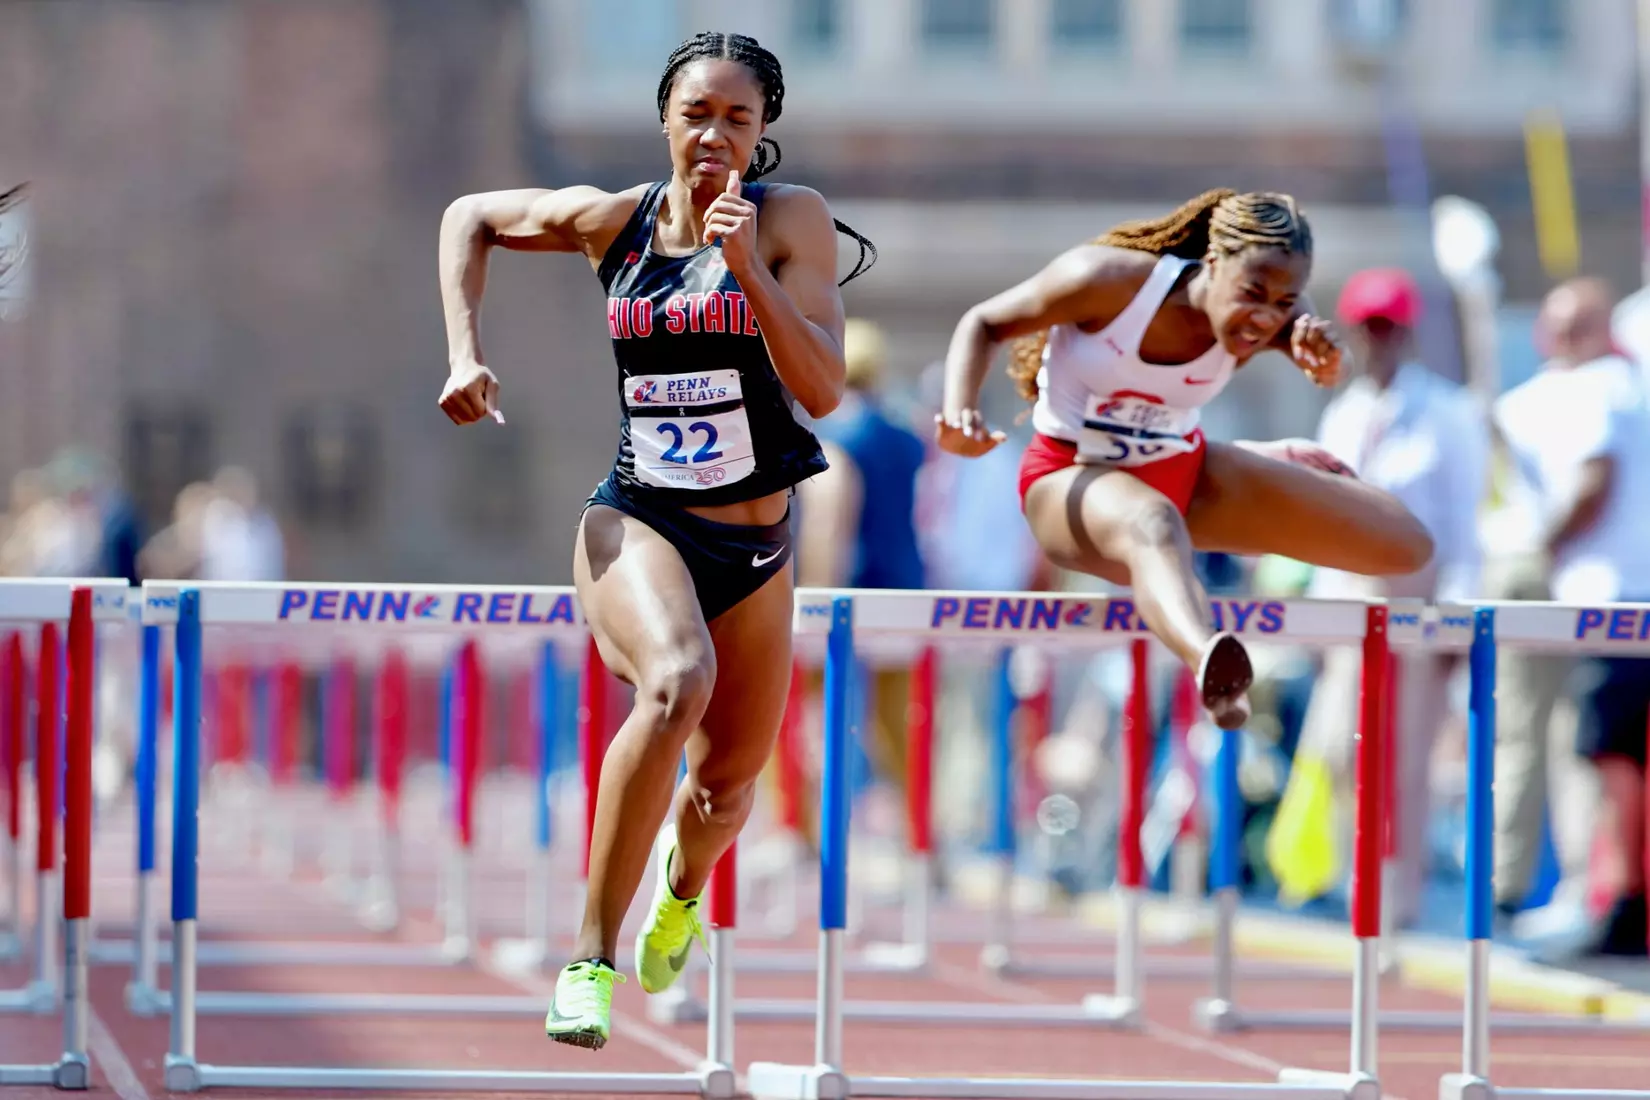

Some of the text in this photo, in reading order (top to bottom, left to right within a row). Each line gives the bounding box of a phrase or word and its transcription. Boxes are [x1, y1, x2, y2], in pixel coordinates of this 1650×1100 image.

[666, 377, 711, 391] PENN
[667, 387, 727, 402] RELAYS
[656, 421, 723, 464] 22
[278, 590, 587, 624] PENN RELA
[931, 597, 1063, 629] PENN
[1575, 609, 1650, 640] PE
